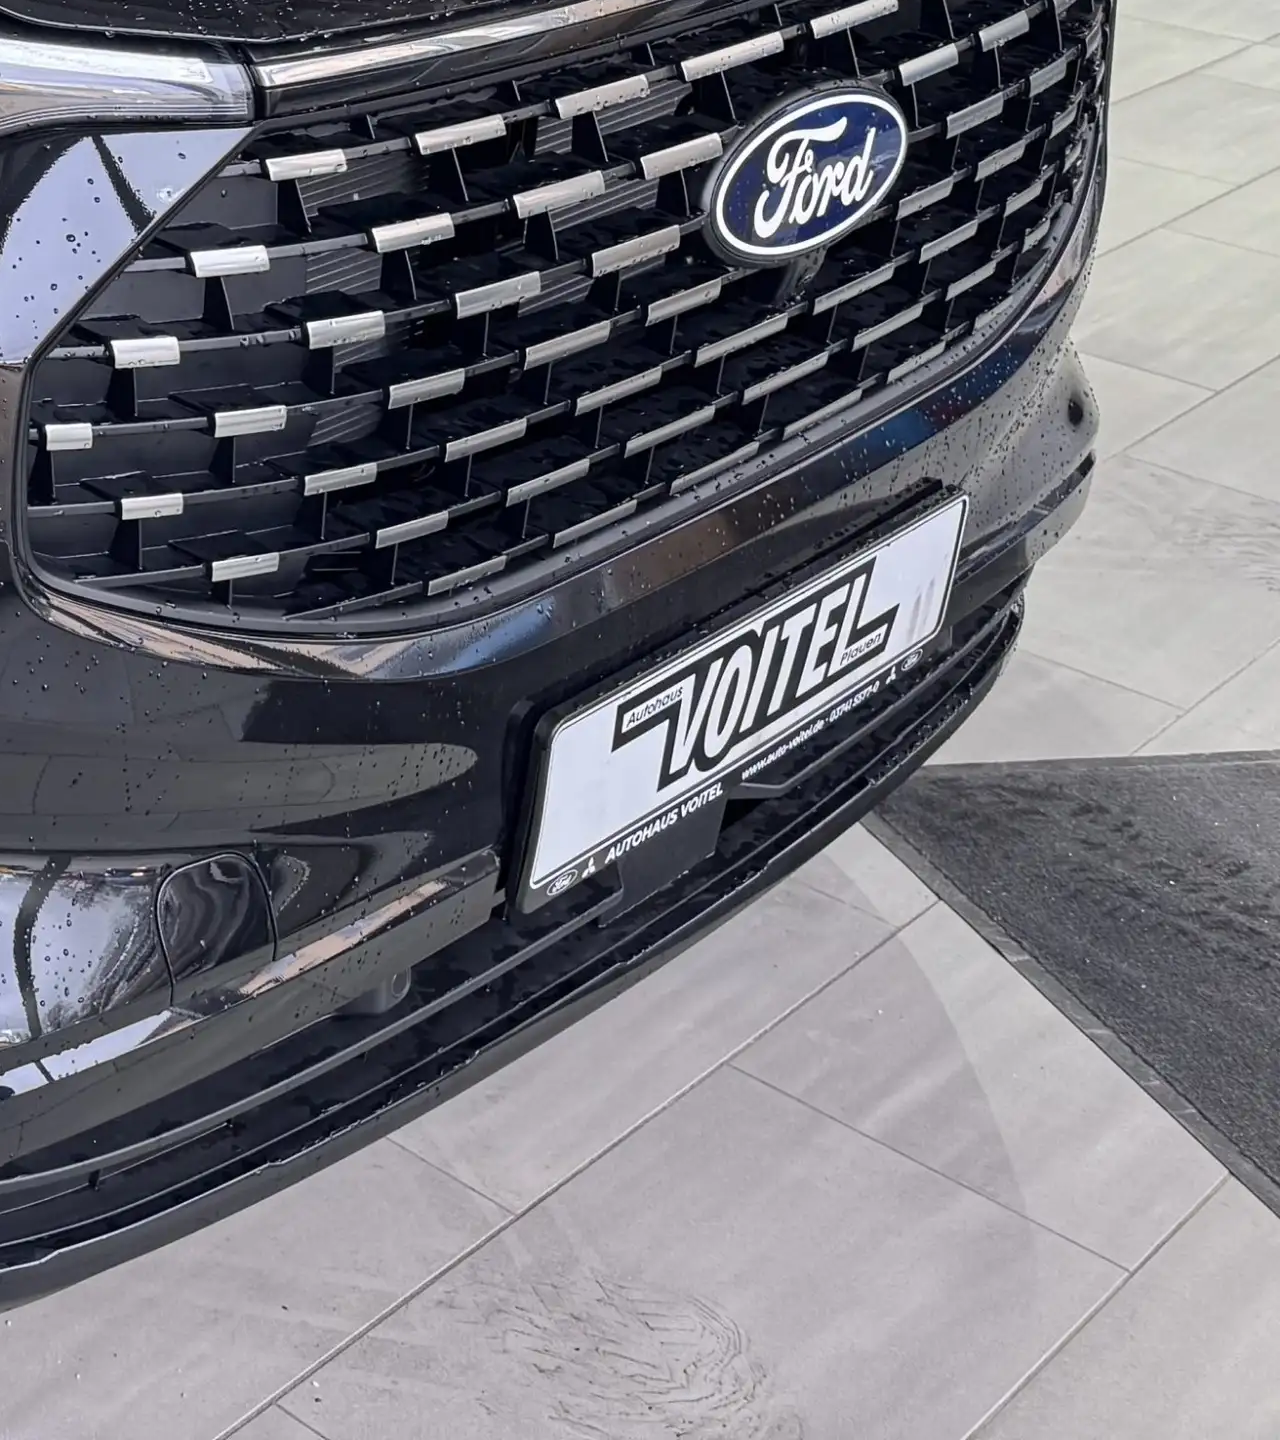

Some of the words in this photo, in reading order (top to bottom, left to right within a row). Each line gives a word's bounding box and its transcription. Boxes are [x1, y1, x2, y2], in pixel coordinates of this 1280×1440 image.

[753, 116, 876, 239] Ford
[662, 565, 875, 782] VOITEL
[840, 633, 882, 667] Plauen
[626, 685, 683, 728] Autohaus
[604, 808, 679, 864] AUTOHAUS
[680, 781, 724, 819] VOITEL
